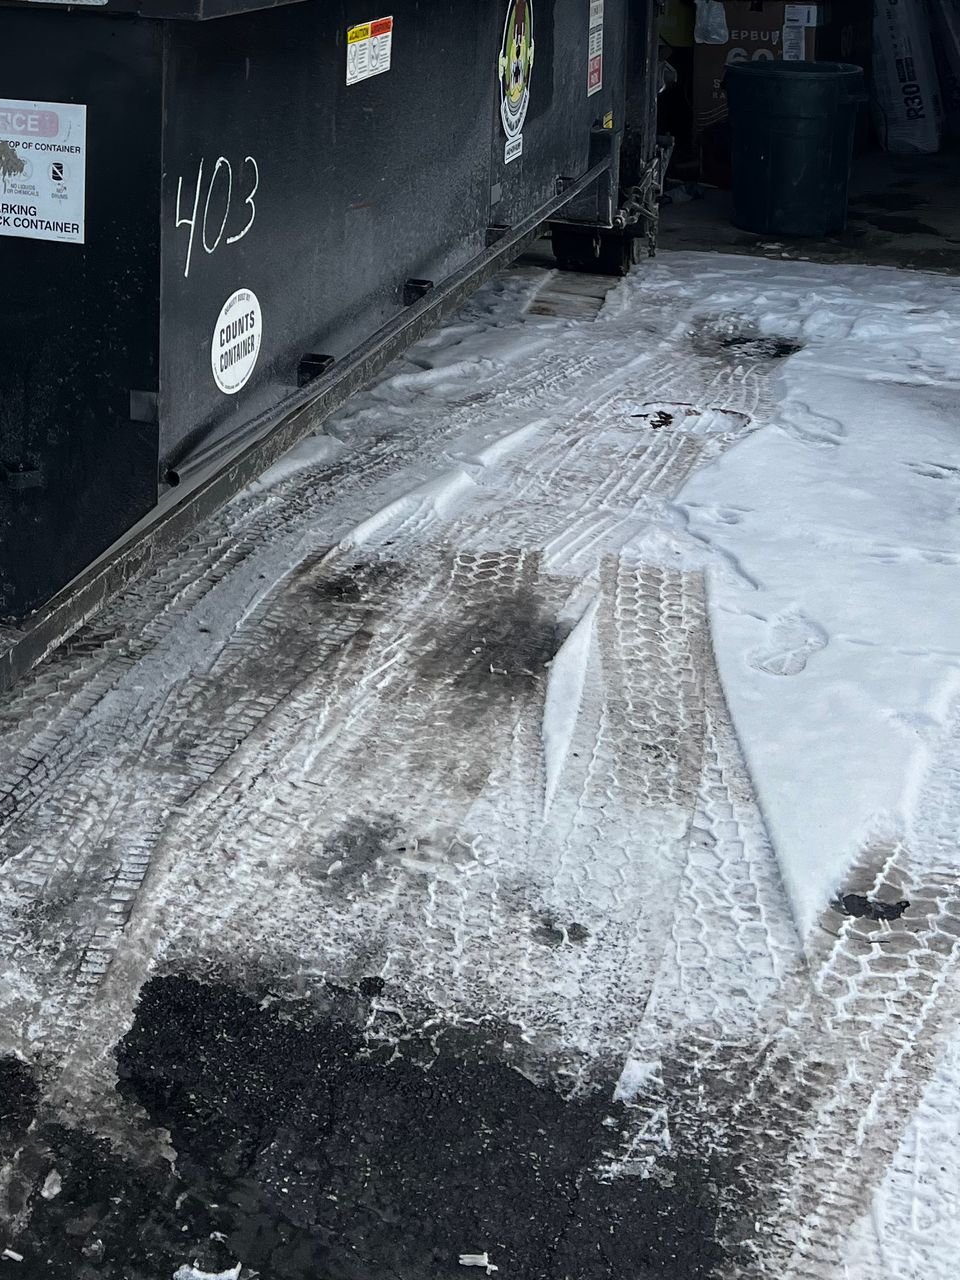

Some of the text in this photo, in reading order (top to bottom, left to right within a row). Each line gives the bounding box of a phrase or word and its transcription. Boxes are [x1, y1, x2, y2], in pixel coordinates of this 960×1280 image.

[730, 30, 780, 42] EPBU
[901, 83, 925, 120] R30
[21, 141, 33, 150] OF
[34, 142, 81, 154] CONTAINER
[13, 216, 80, 234] CONTAINER
[175, 156, 260, 278] 403
[219, 309, 255, 348] COUNTS
[219, 334, 255, 373] CONTAINER
